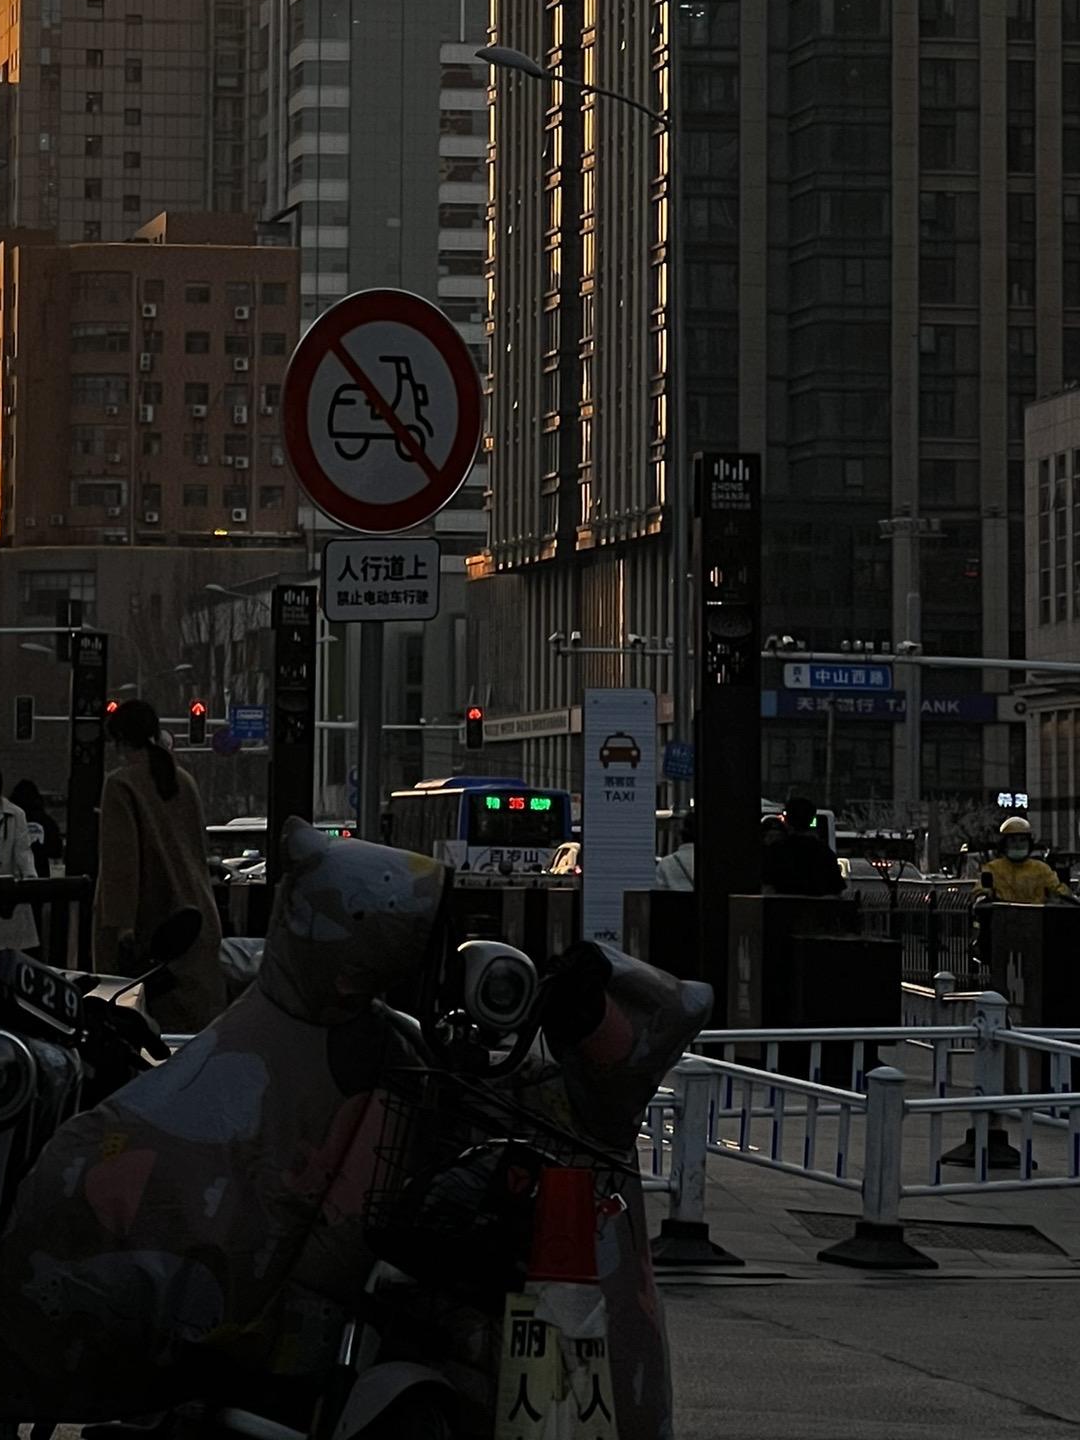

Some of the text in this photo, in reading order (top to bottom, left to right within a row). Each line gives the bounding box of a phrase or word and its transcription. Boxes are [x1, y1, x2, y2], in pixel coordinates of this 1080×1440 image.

[337, 555, 428, 582] 人行道上
[337, 590, 428, 606] 禁止电动车行驶
[815, 668, 884, 685] 中山西路
[885, 699, 961, 713] TJANK
[604, 791, 635, 802] TAXI
[490, 849, 539, 864] 百岁山
